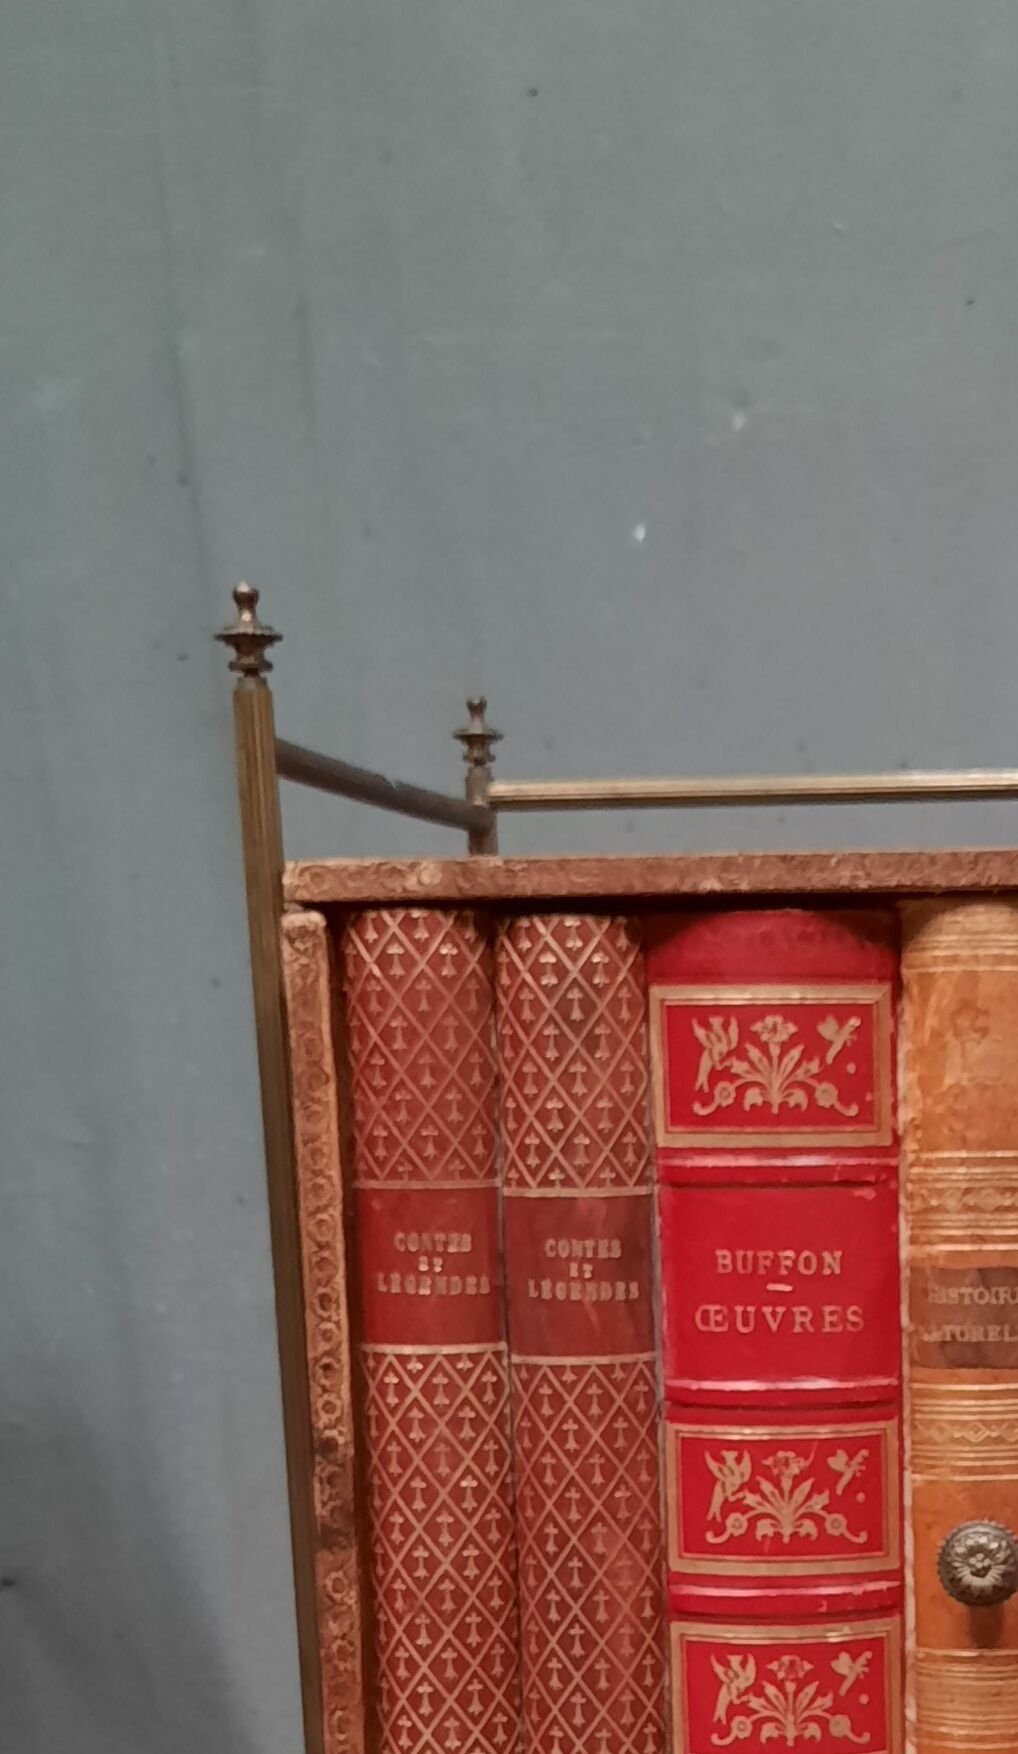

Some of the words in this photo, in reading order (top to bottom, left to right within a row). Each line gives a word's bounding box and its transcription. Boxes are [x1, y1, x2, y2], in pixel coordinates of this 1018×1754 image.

[544, 1238, 623, 1259] CONTES
[715, 1249, 843, 1276] BUFFON
[694, 1303, 866, 1334] ŒUVRES
